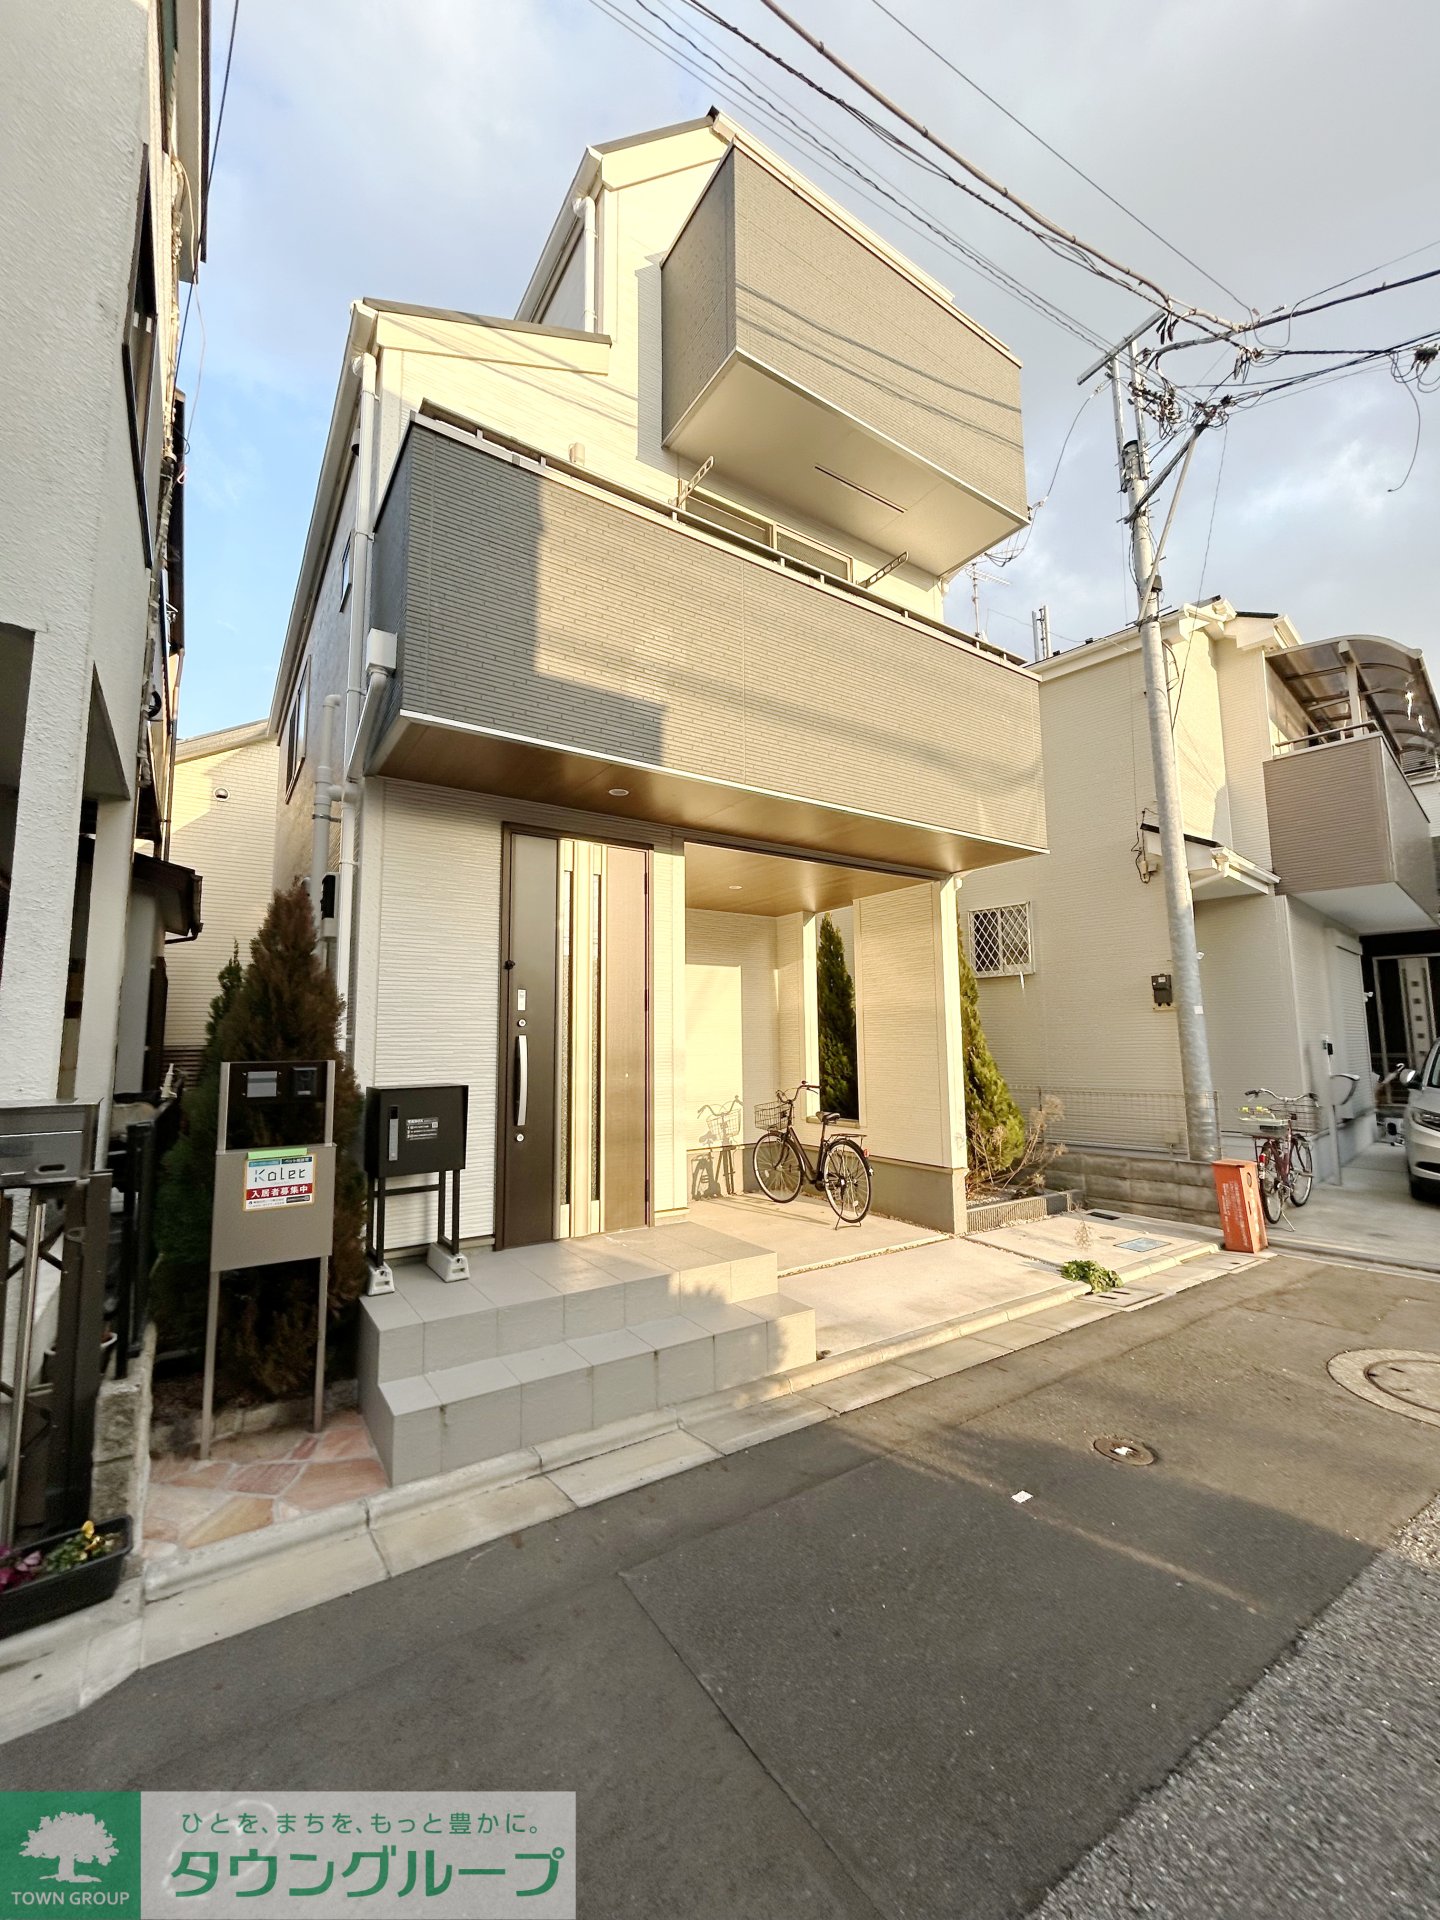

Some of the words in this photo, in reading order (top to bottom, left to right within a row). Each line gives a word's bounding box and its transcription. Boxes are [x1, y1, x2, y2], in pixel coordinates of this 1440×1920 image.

[251, 1185, 308, 1199] 入居者募集中
